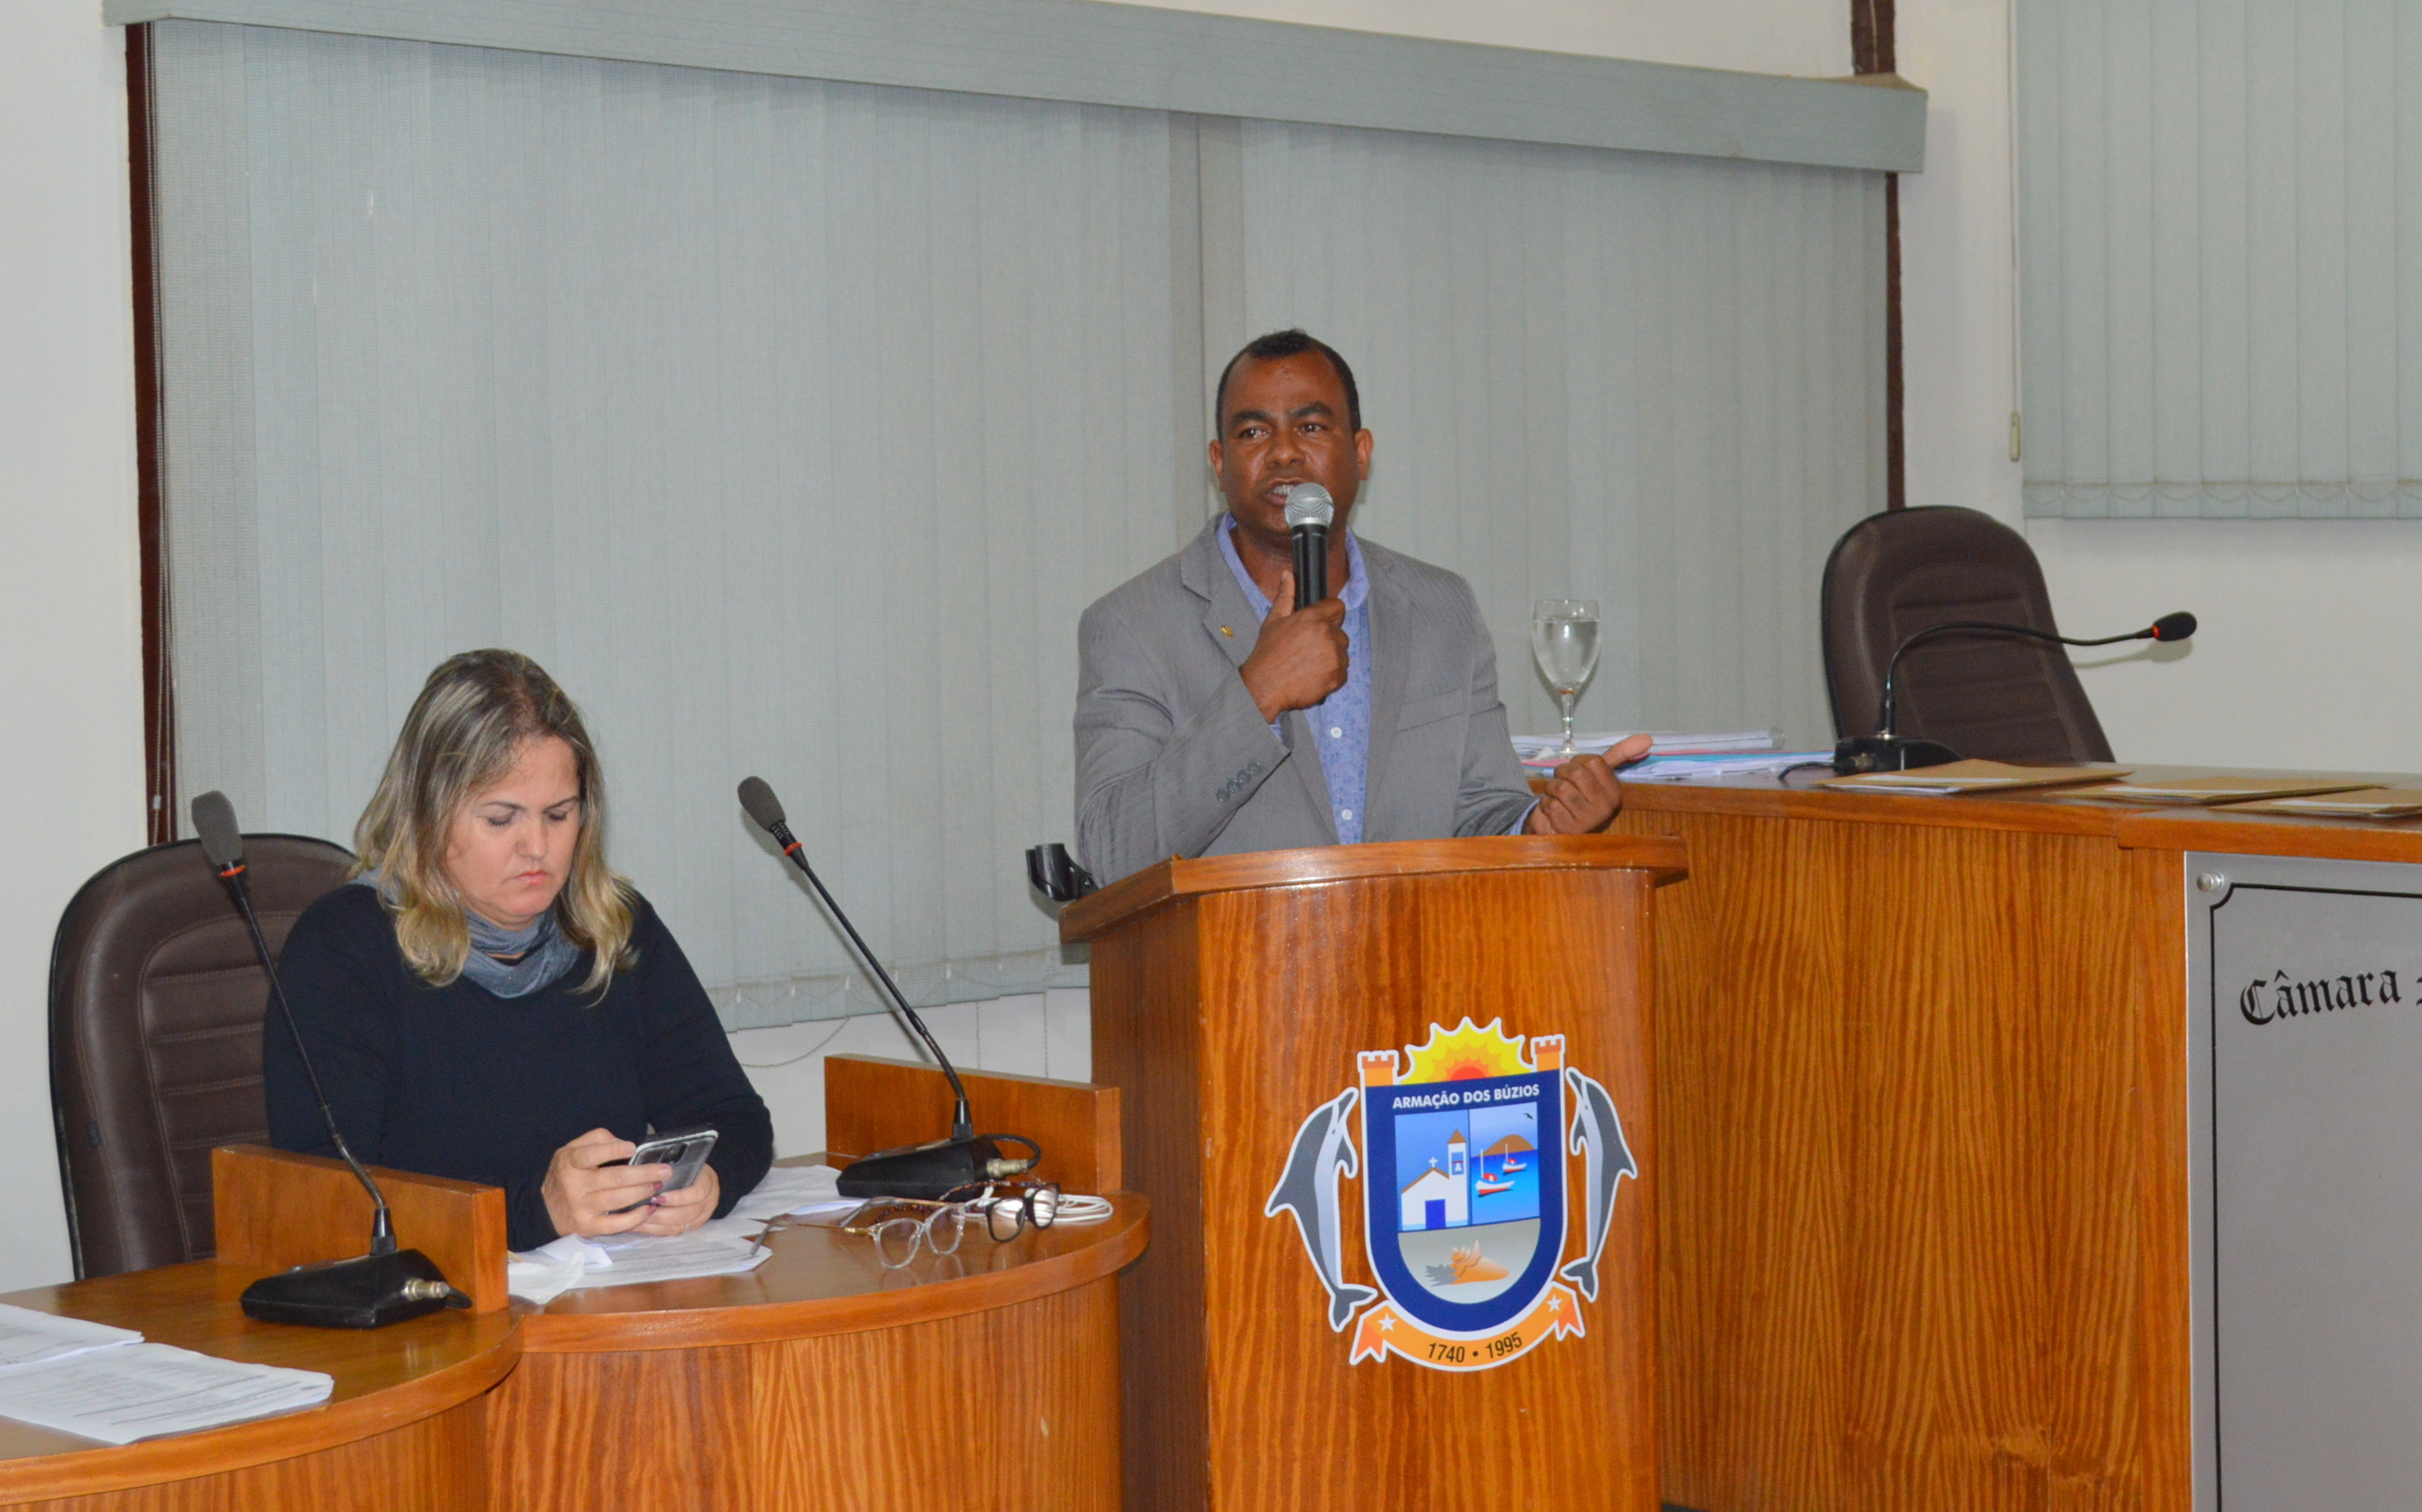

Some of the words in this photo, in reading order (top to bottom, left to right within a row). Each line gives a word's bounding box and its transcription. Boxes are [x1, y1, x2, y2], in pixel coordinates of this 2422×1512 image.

[2239, 969, 2402, 1026] Câmara
[1392, 1091, 1460, 1109] ARMAÇÃO
[1463, 1090, 1491, 1104] DOS
[1494, 1083, 1540, 1101] BÚZIOS
[1429, 1342, 1466, 1363] 1740
[1485, 1331, 1522, 1359] 1995
